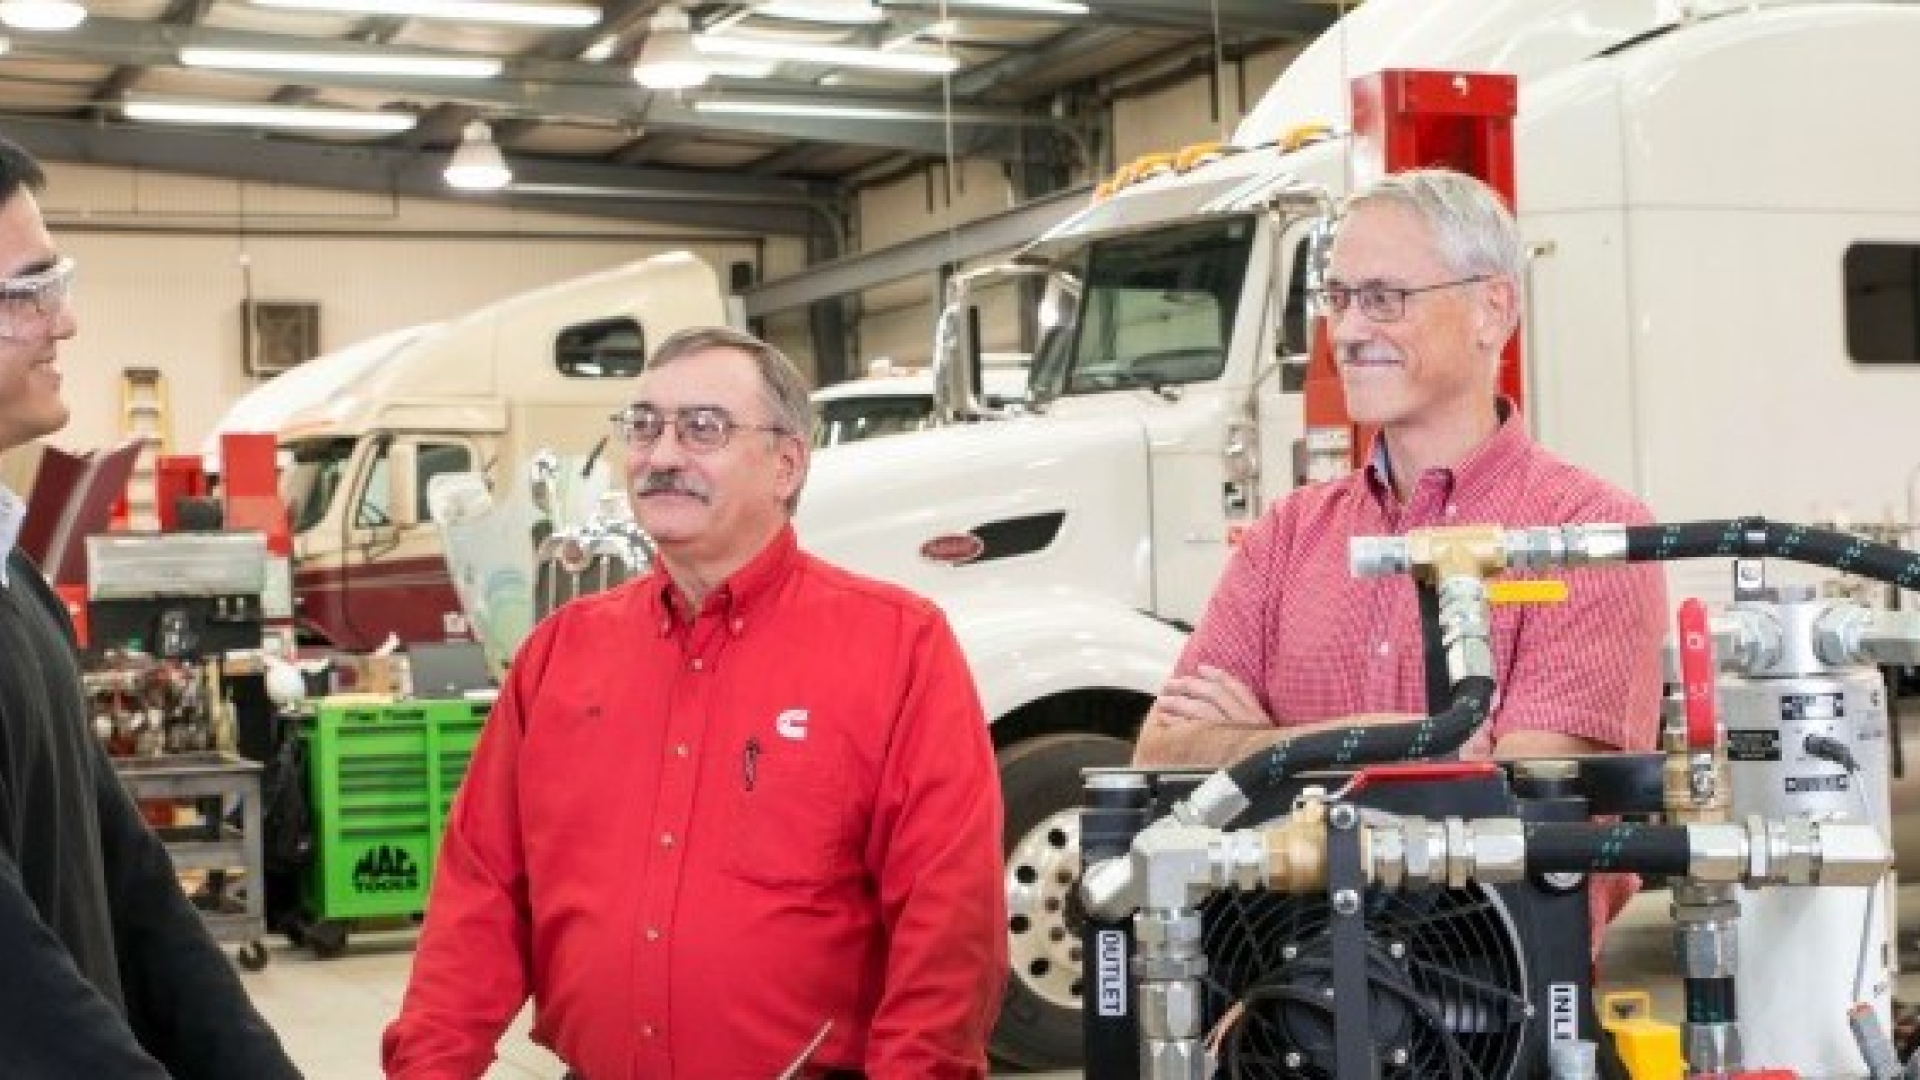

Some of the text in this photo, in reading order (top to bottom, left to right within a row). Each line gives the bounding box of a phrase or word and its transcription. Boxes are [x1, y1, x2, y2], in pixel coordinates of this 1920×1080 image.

[353, 845, 420, 893] MAC TOOLS
[1102, 933, 1120, 1013] OUTLET
